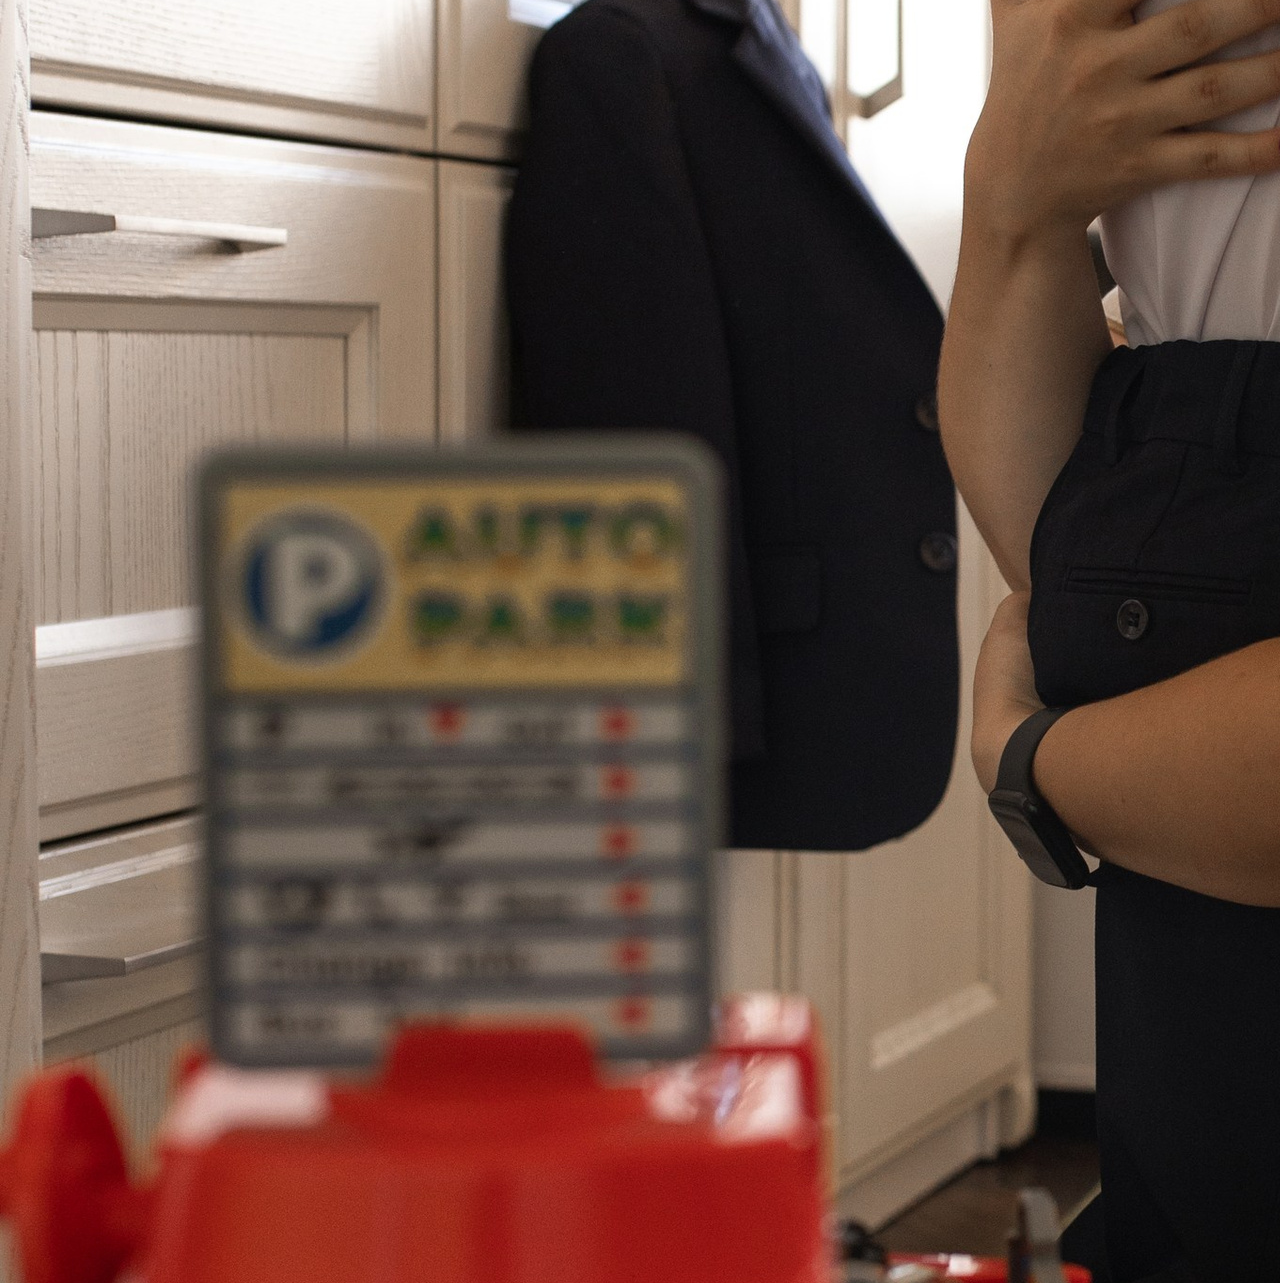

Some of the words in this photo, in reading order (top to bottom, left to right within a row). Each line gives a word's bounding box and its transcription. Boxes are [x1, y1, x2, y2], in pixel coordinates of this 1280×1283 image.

[402, 502, 682, 572] AUTO
[270, 527, 363, 644] P
[408, 588, 674, 656] PARK
